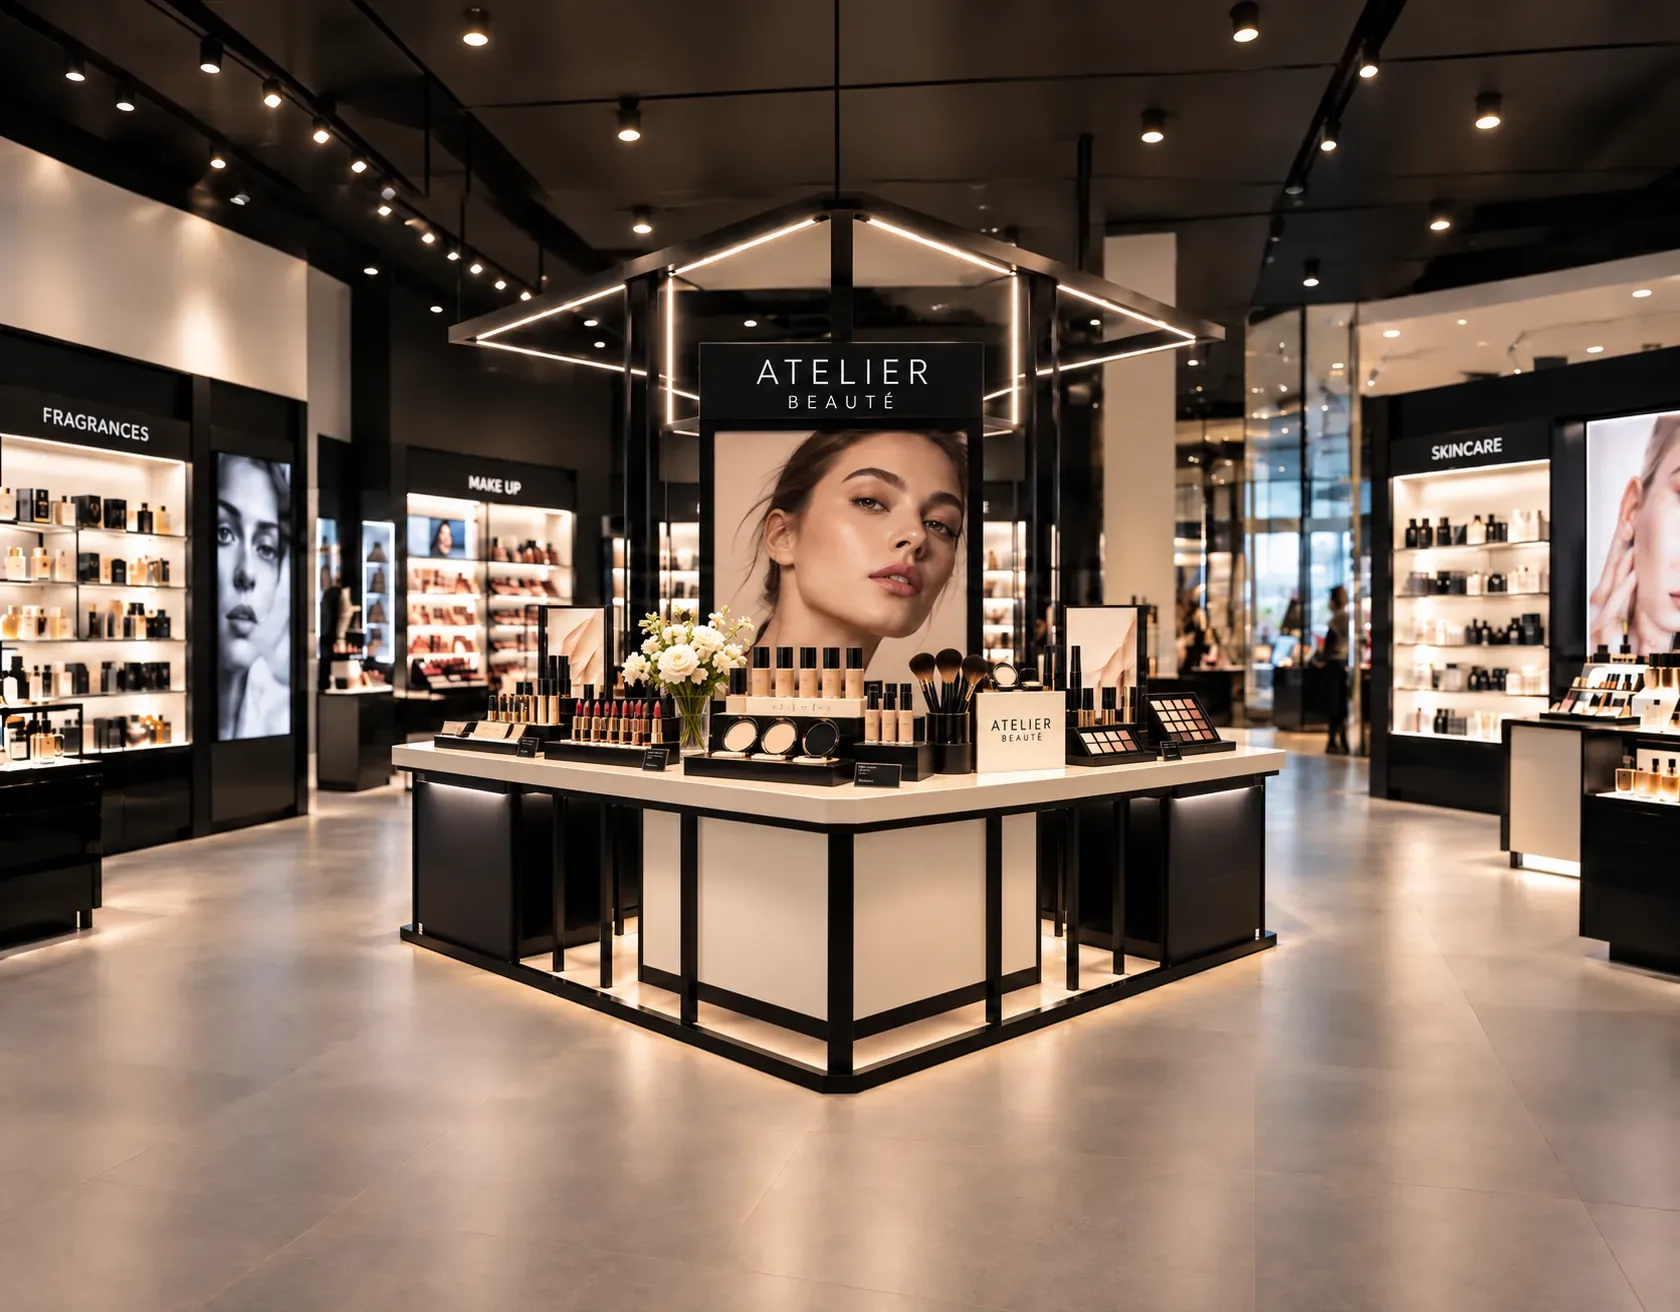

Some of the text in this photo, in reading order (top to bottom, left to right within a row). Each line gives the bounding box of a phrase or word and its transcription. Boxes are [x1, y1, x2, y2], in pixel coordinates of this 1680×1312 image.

[756, 358, 928, 385] ATELIER
[788, 391, 894, 410] BEAUTÉ
[42, 406, 150, 443] FRAGRANCES
[1431, 437, 1503, 461] SKINCARE
[468, 475, 522, 495] MAKE UP
[991, 717, 1052, 732] ATELIER
[1001, 731, 1042, 743] BEAUTÉ
